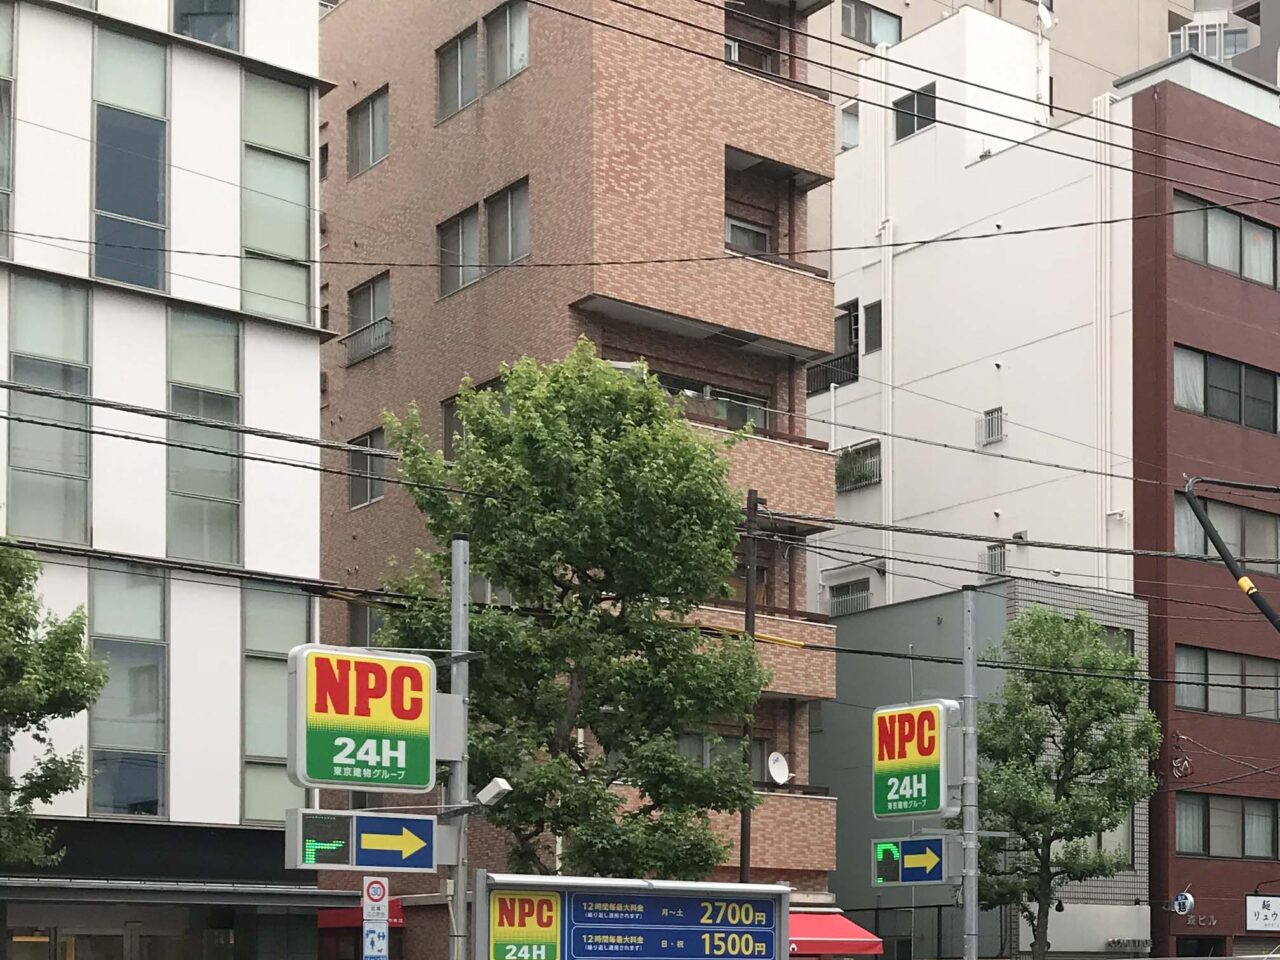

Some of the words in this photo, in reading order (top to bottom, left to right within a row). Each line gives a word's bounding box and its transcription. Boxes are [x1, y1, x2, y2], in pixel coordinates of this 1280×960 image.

[315, 657, 423, 720] NPC
[877, 711, 935, 761] NPC
[333, 737, 406, 768] 24H
[333, 766, 406, 780] 東京建物グループ
[887, 774, 926, 801] 24H
[498, 897, 553, 928] NPC
[700, 902, 766, 926] 2700円
[505, 945, 547, 960] 24H
[701, 933, 766, 956] 1500円
